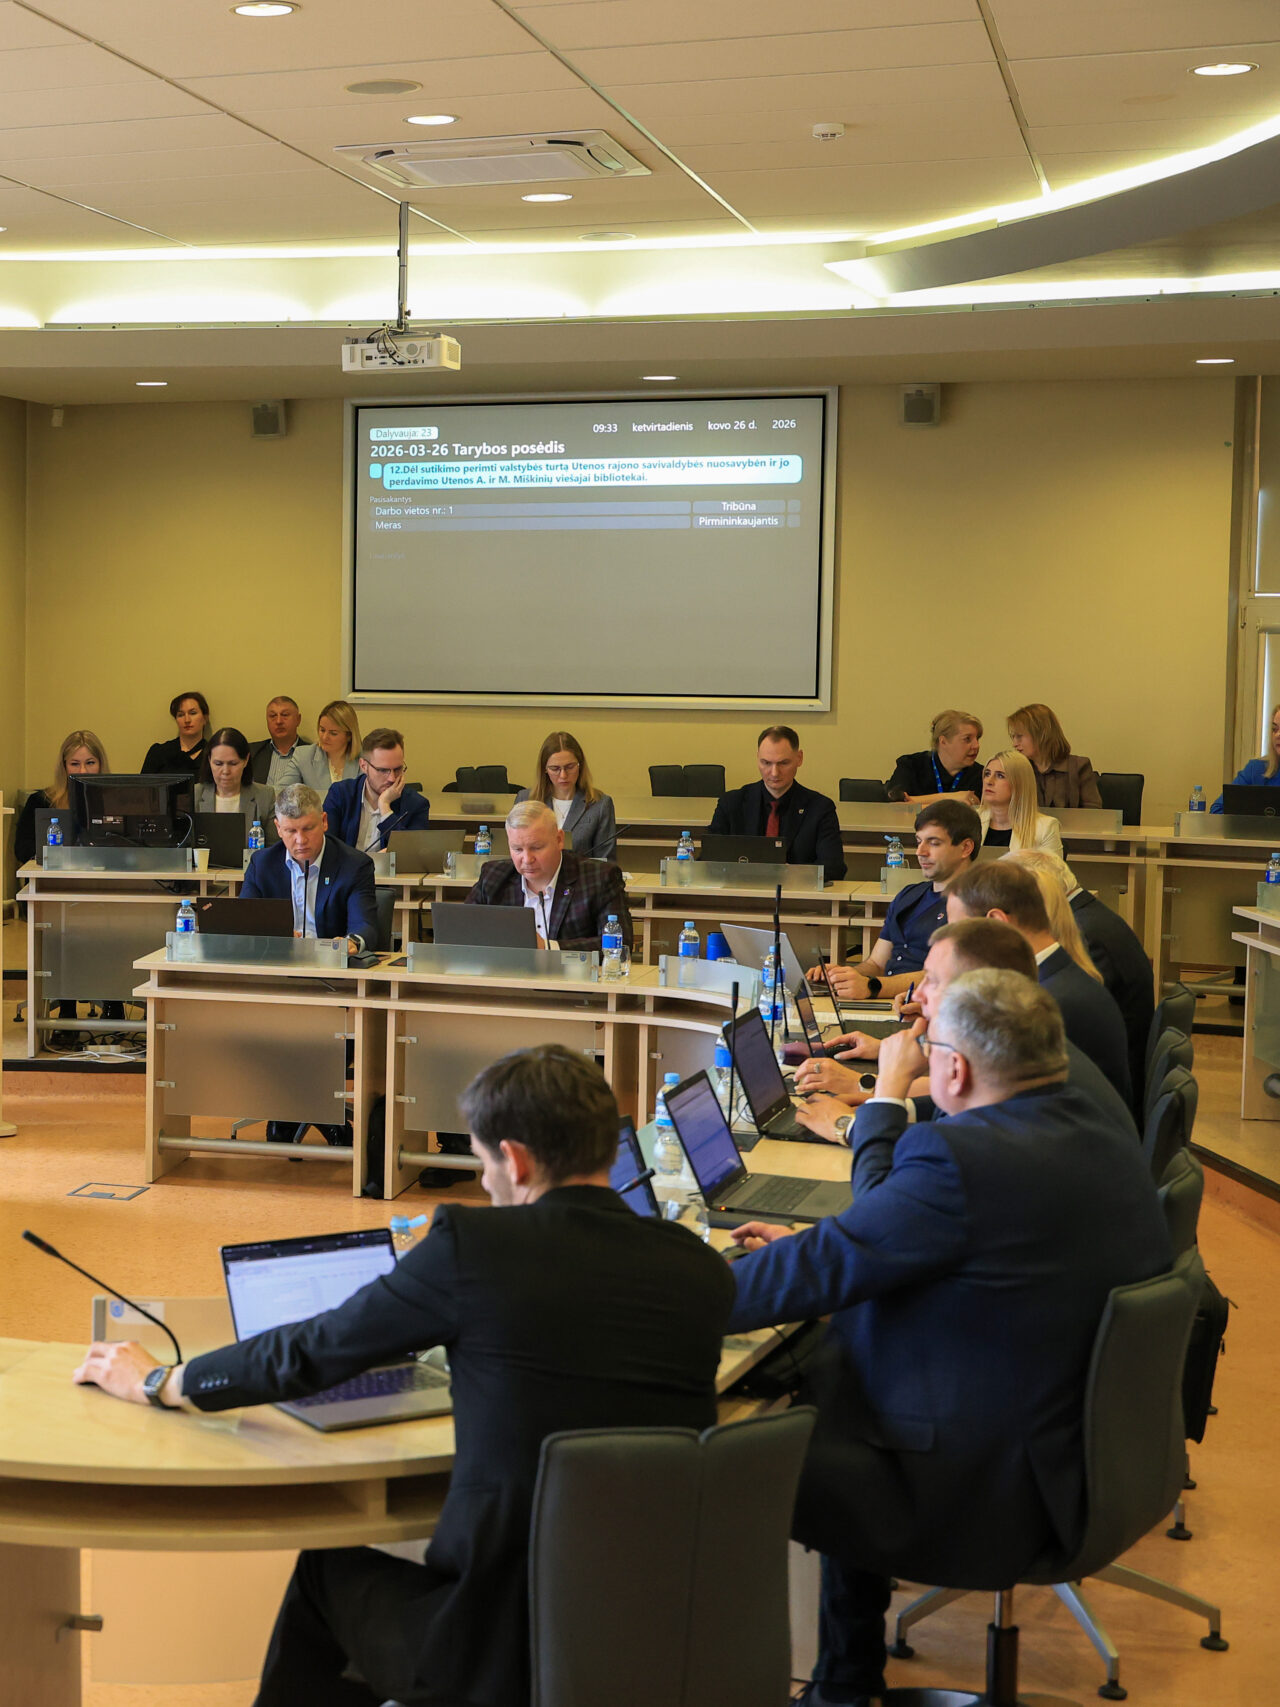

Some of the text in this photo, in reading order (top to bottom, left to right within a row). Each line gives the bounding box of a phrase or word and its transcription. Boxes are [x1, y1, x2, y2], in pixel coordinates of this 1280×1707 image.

[592, 422, 694, 433] 09:33 ketvirtadienis
[708, 420, 758, 430] kovo 26 d.
[772, 420, 796, 429] 2026
[376, 429, 432, 440] Dalyvauja: 23
[370, 441, 565, 458] 2026-03-26 Tarybos posėdis
[390, 465, 418, 474] 12.Dėl
[421, 464, 461, 473] sutikimo
[463, 464, 497, 475] perimti
[499, 463, 543, 474] valstybės
[571, 462, 605, 471] Utenos
[608, 461, 639, 471] rajono
[642, 460, 704, 470] savivaldybės
[707, 459, 766, 470] nuosavybėn
[769, 458, 777, 467] ir
[779, 458, 789, 469] jo
[389, 473, 648, 487] perdavimo Utenos A. ir M. Miškinių viešajai bibliotekai.
[369, 496, 412, 504] Pasisakantys
[375, 507, 402, 515] Darbo
[404, 507, 430, 515] vietos
[449, 506, 453, 514] 1
[722, 502, 757, 511] Tribūna
[375, 521, 402, 529] Meras
[699, 516, 778, 528] Pirmininkaujantis
